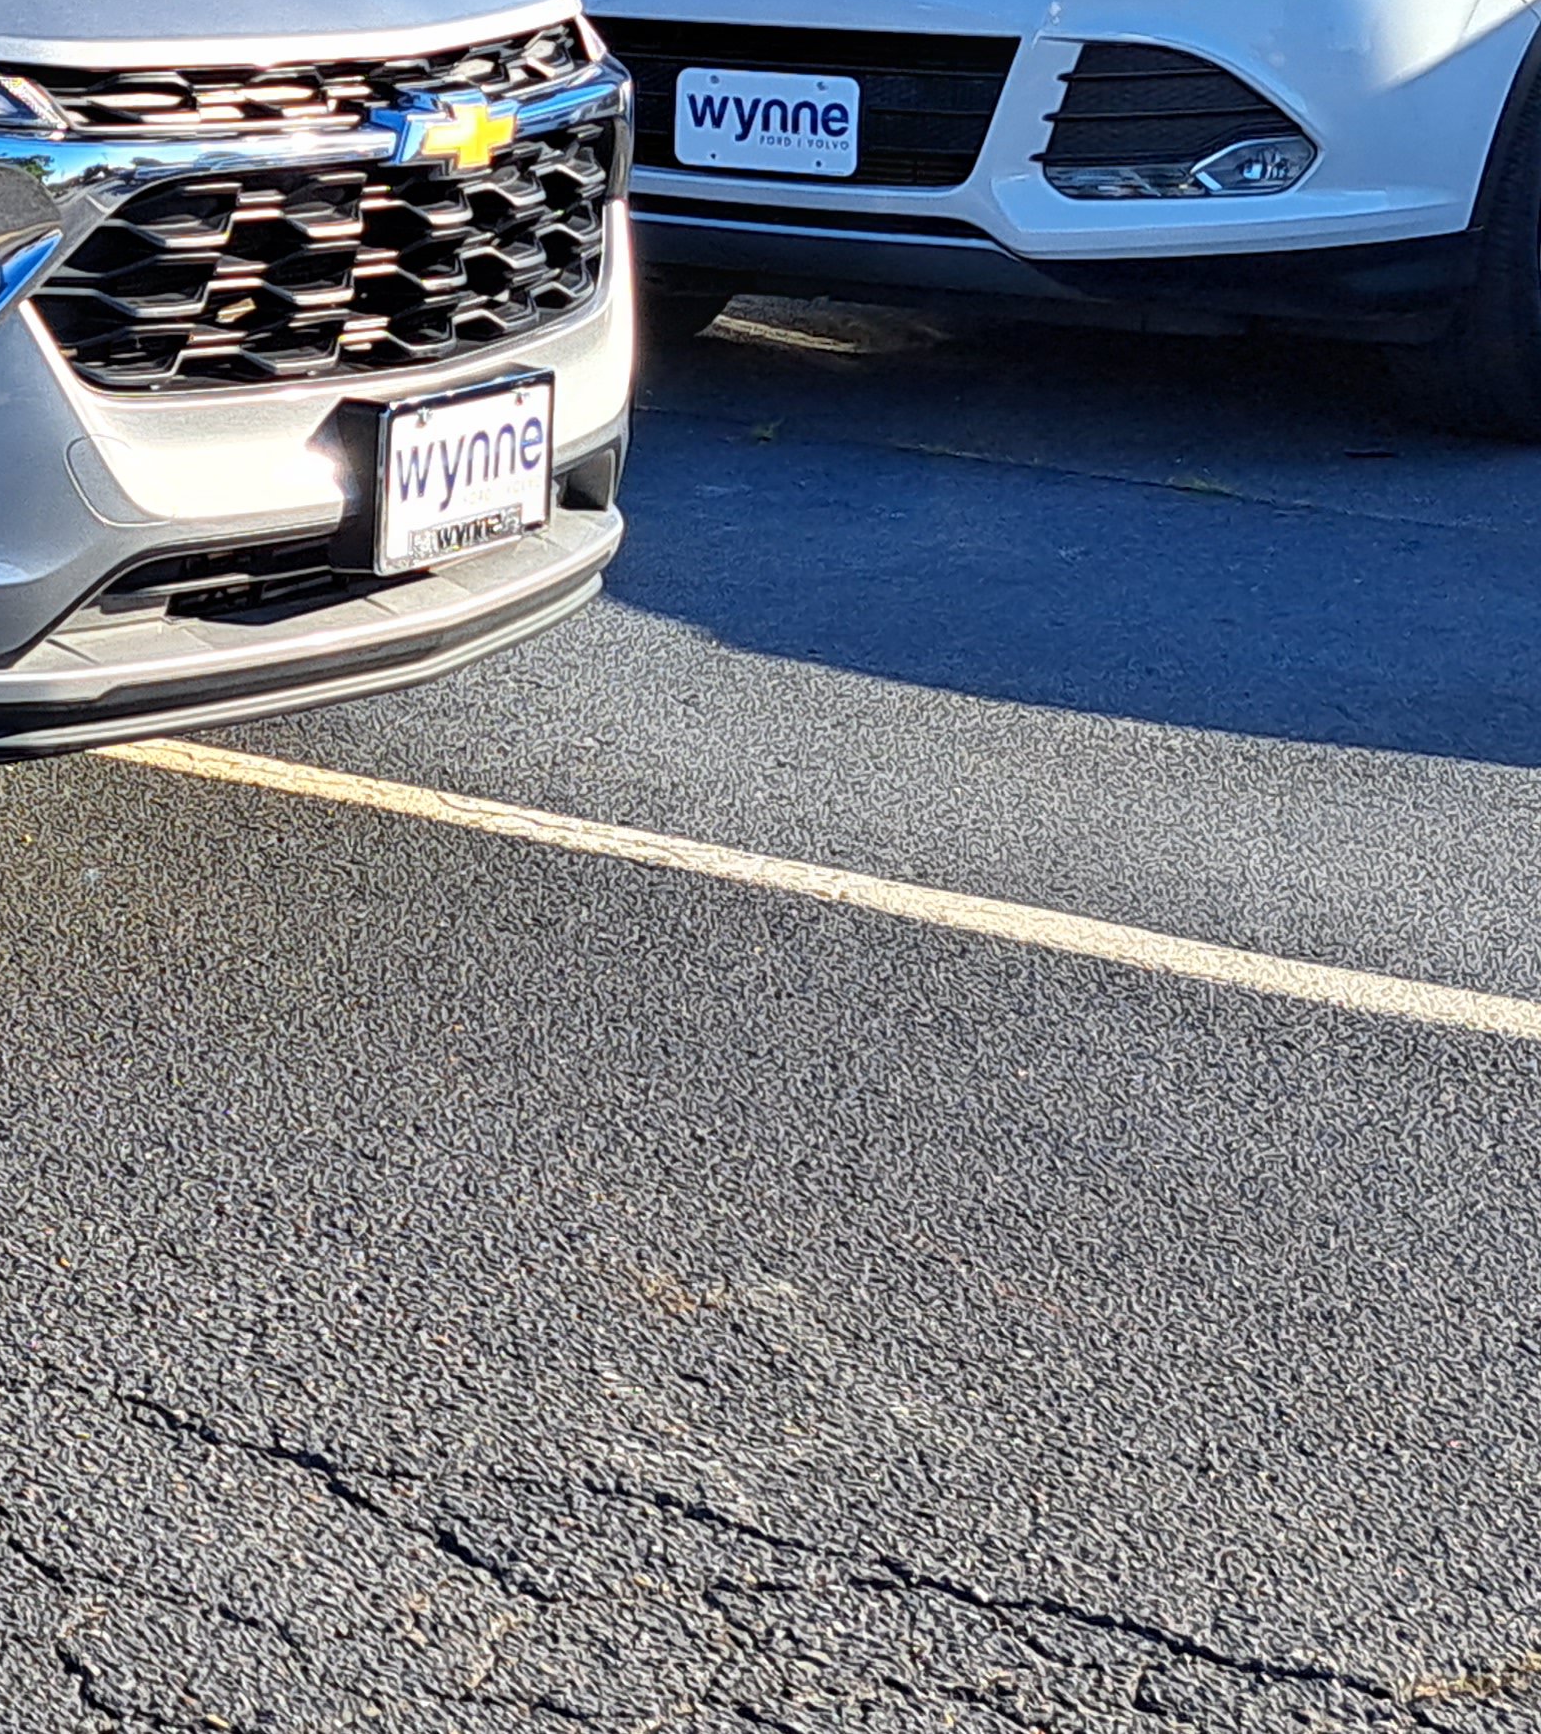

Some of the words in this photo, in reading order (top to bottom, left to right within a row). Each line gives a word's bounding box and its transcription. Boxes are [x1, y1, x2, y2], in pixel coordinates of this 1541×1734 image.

[688, 93, 850, 142] wynne
[759, 135, 792, 148] FORD
[807, 139, 850, 151] VOLVO
[396, 416, 544, 513] wynne
